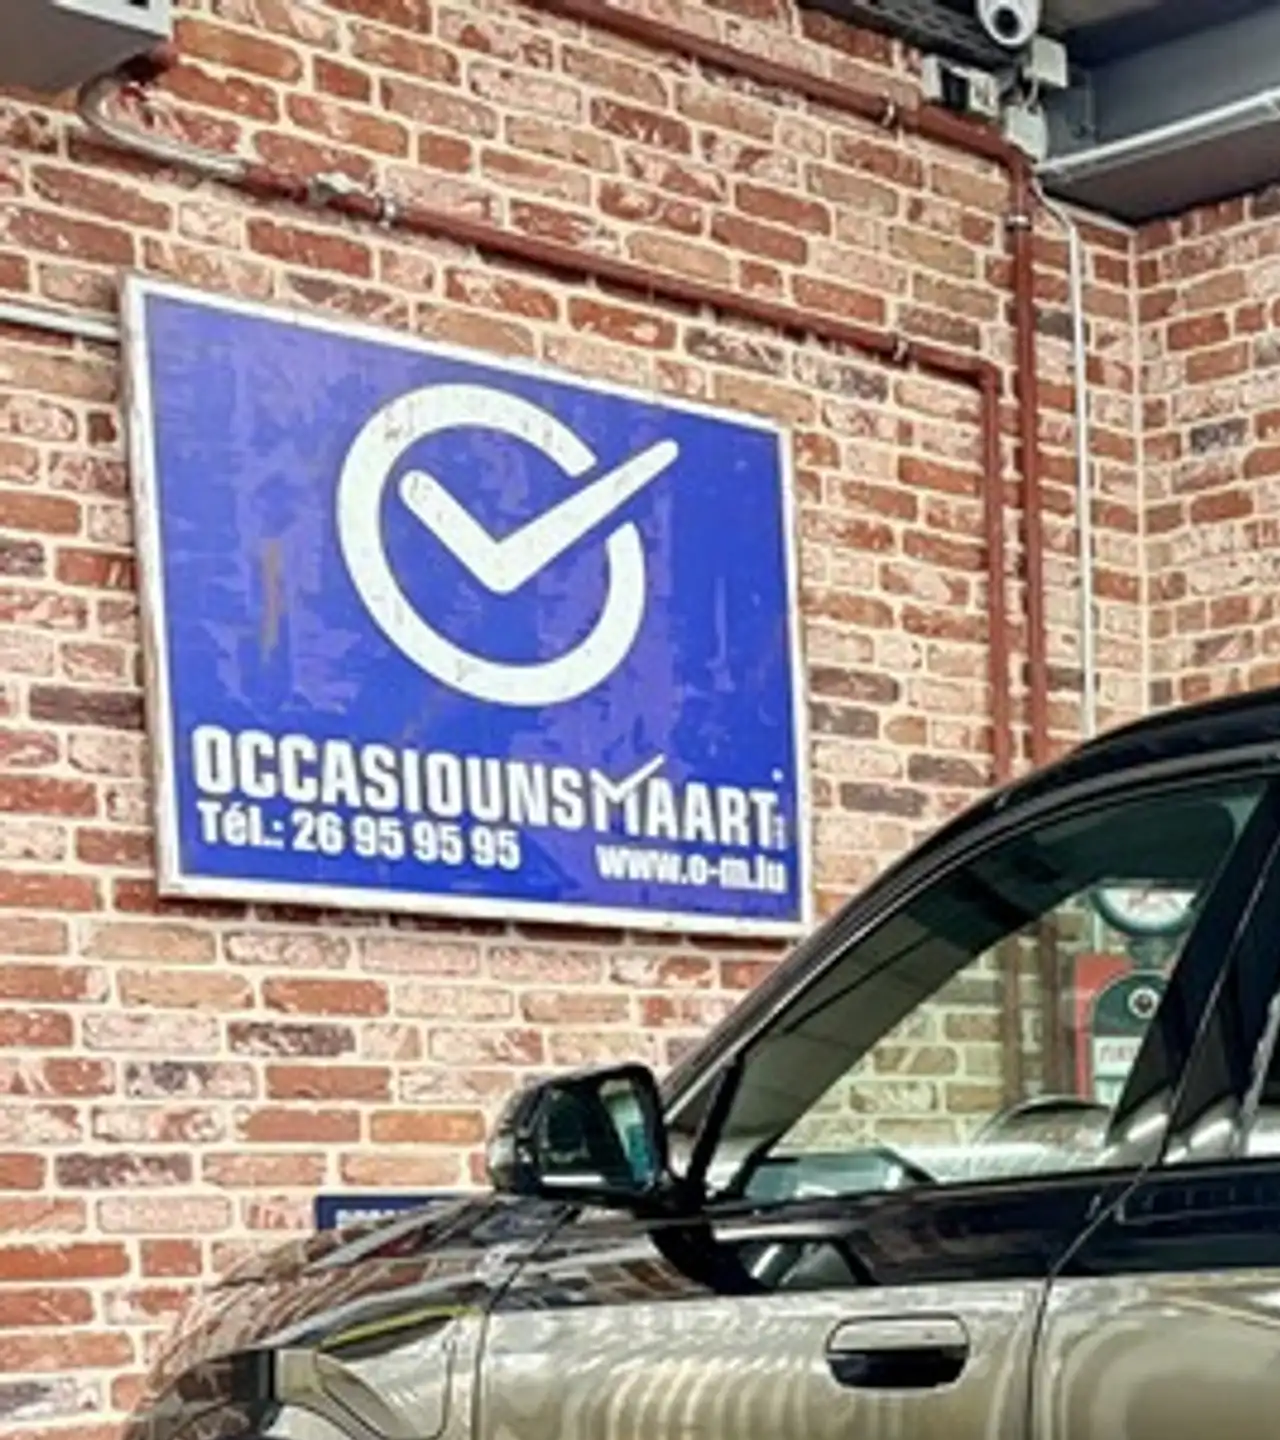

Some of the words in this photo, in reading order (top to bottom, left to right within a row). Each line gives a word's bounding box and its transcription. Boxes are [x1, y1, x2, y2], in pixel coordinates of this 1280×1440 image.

[291, 808, 345, 856] 26
[352, 815, 405, 861] 95
[412, 820, 465, 867] 95
[470, 826, 522, 872] 95
[595, 844, 788, 893] www.o-m.lu
